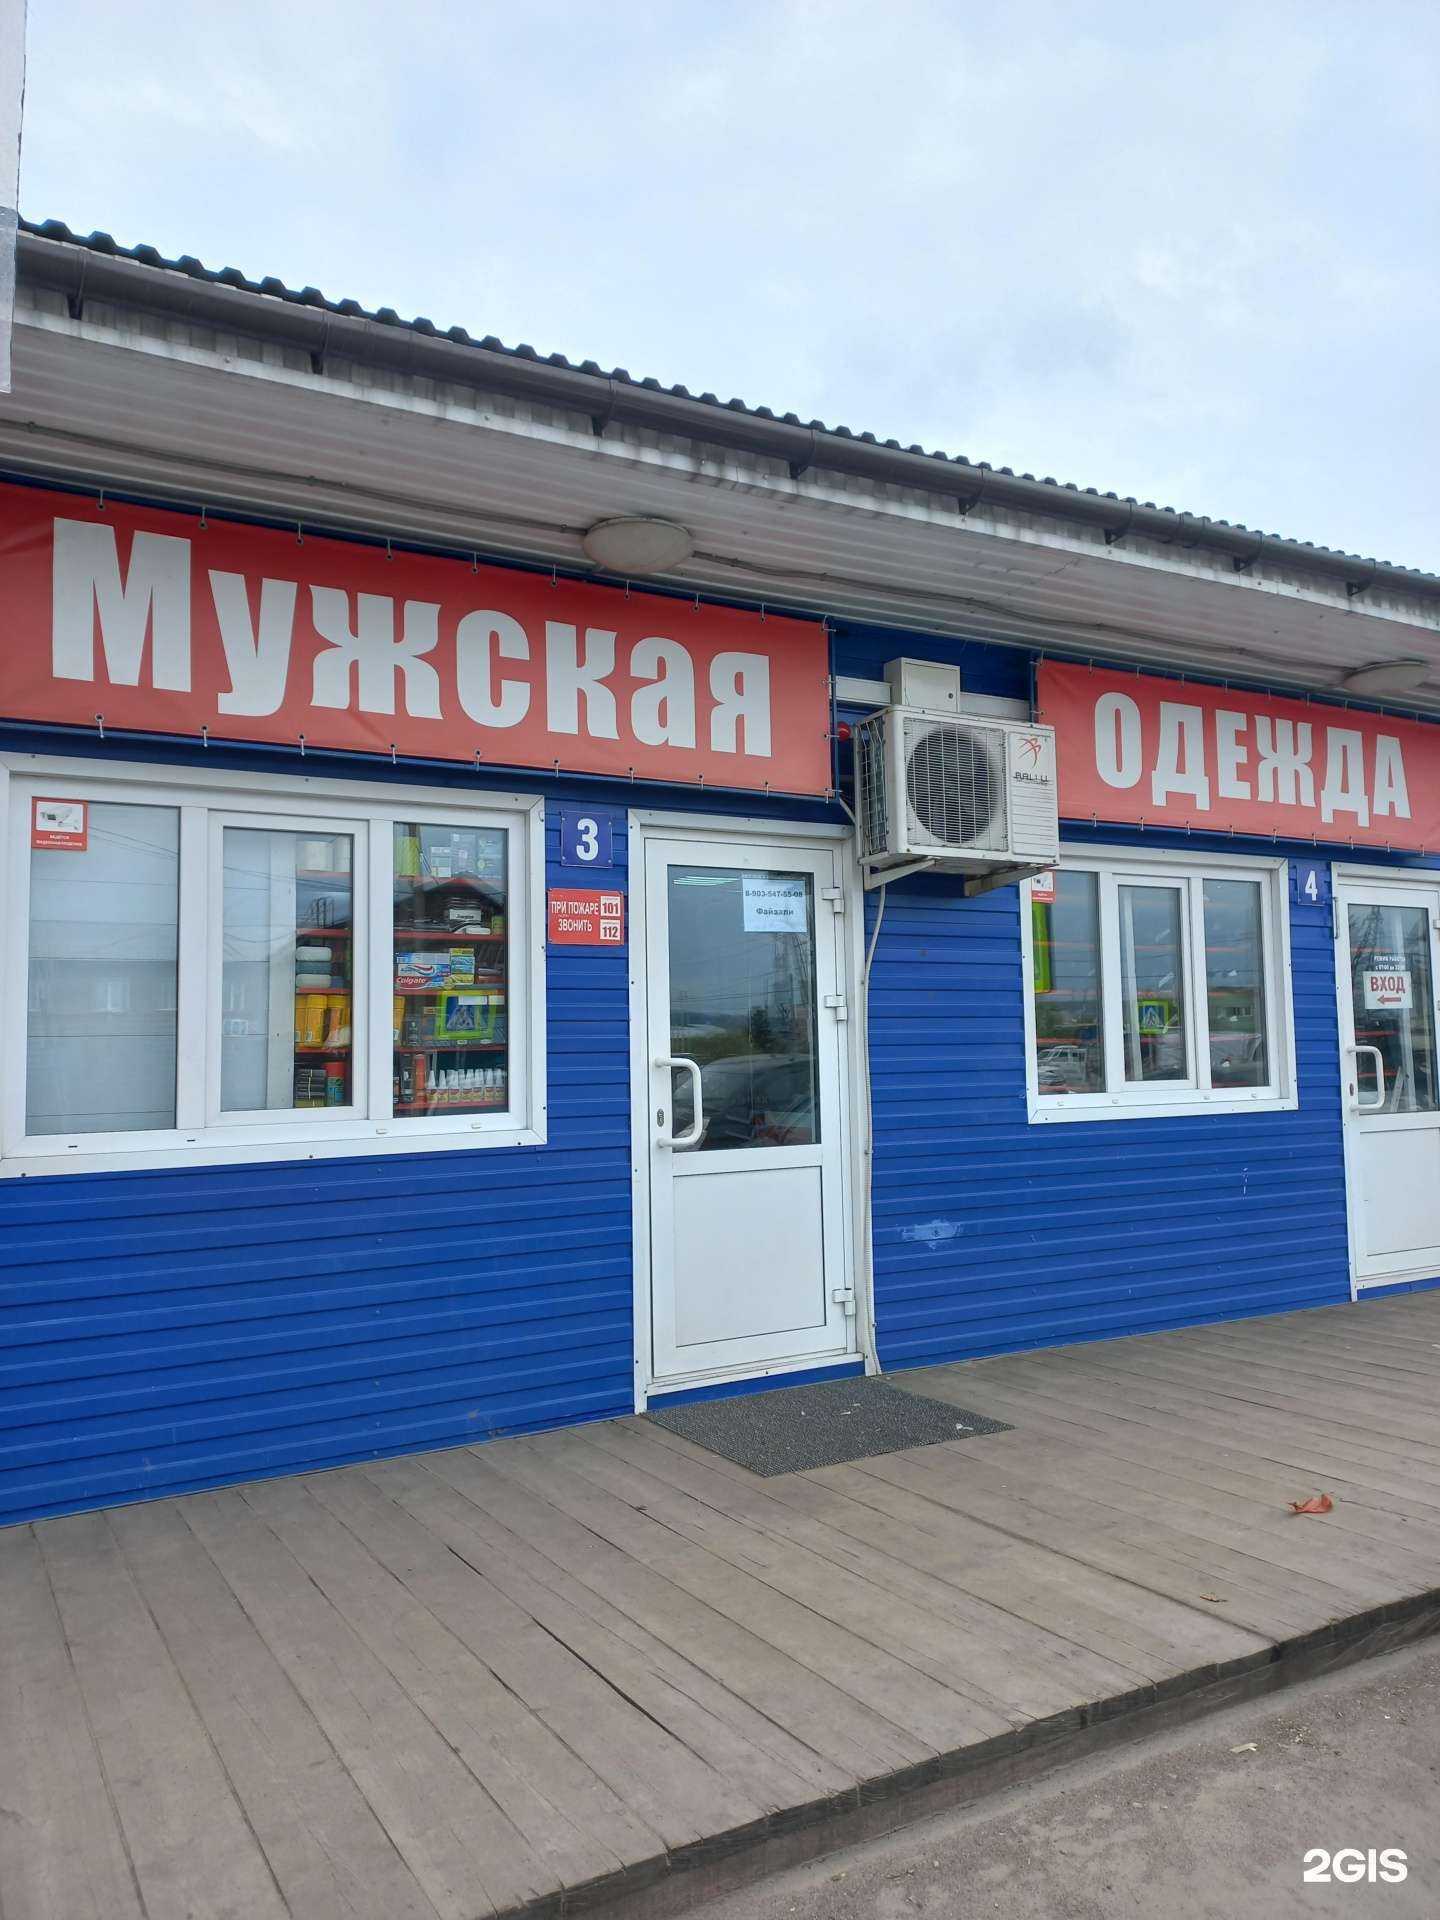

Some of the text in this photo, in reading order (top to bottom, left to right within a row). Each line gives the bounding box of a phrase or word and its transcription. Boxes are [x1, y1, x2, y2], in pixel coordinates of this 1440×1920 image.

[52, 517, 772, 758] Мужская
[1094, 691, 1411, 828] ОДЕЖДА
[575, 817, 599, 861] 3
[1304, 870, 1318, 901] 4
[551, 901, 619, 915] ПРИ ПОЖАРЕ 101
[558, 919, 618, 938] ЗВОНИТЬ 112
[396, 975, 426, 985] Colgate
[1370, 975, 1406, 994] ВХОД
